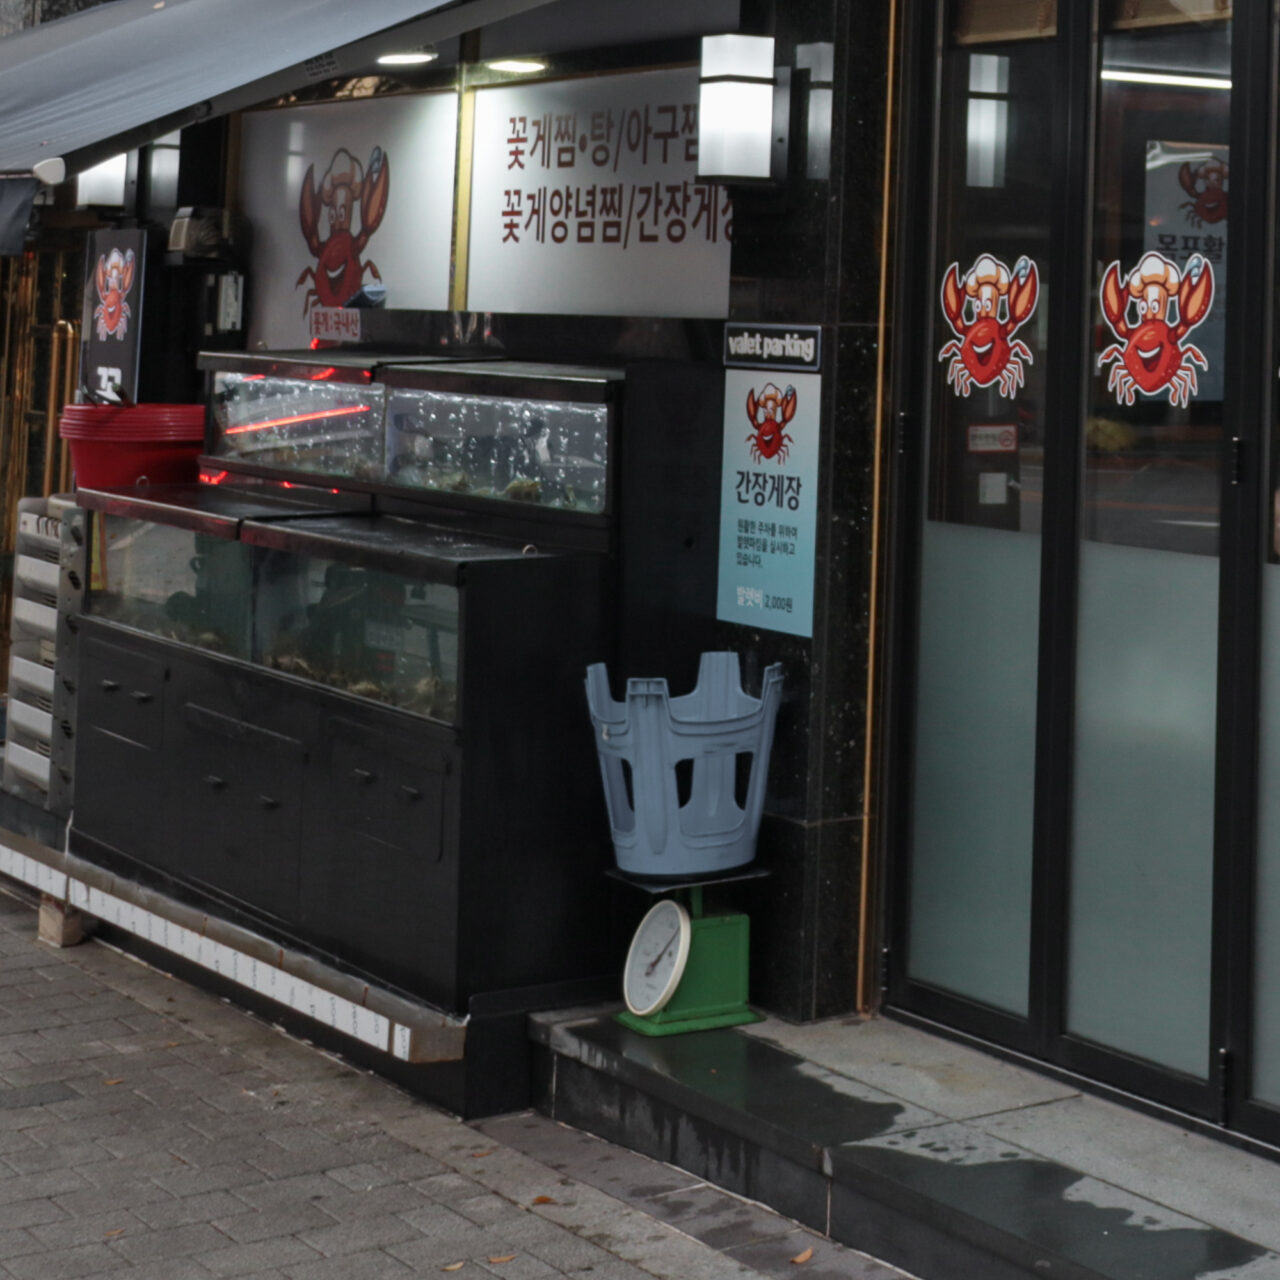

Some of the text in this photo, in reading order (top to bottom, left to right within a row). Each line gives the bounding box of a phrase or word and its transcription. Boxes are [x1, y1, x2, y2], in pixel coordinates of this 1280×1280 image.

[728, 331, 815, 363] valet parking
[735, 471, 802, 511] 간장게장
